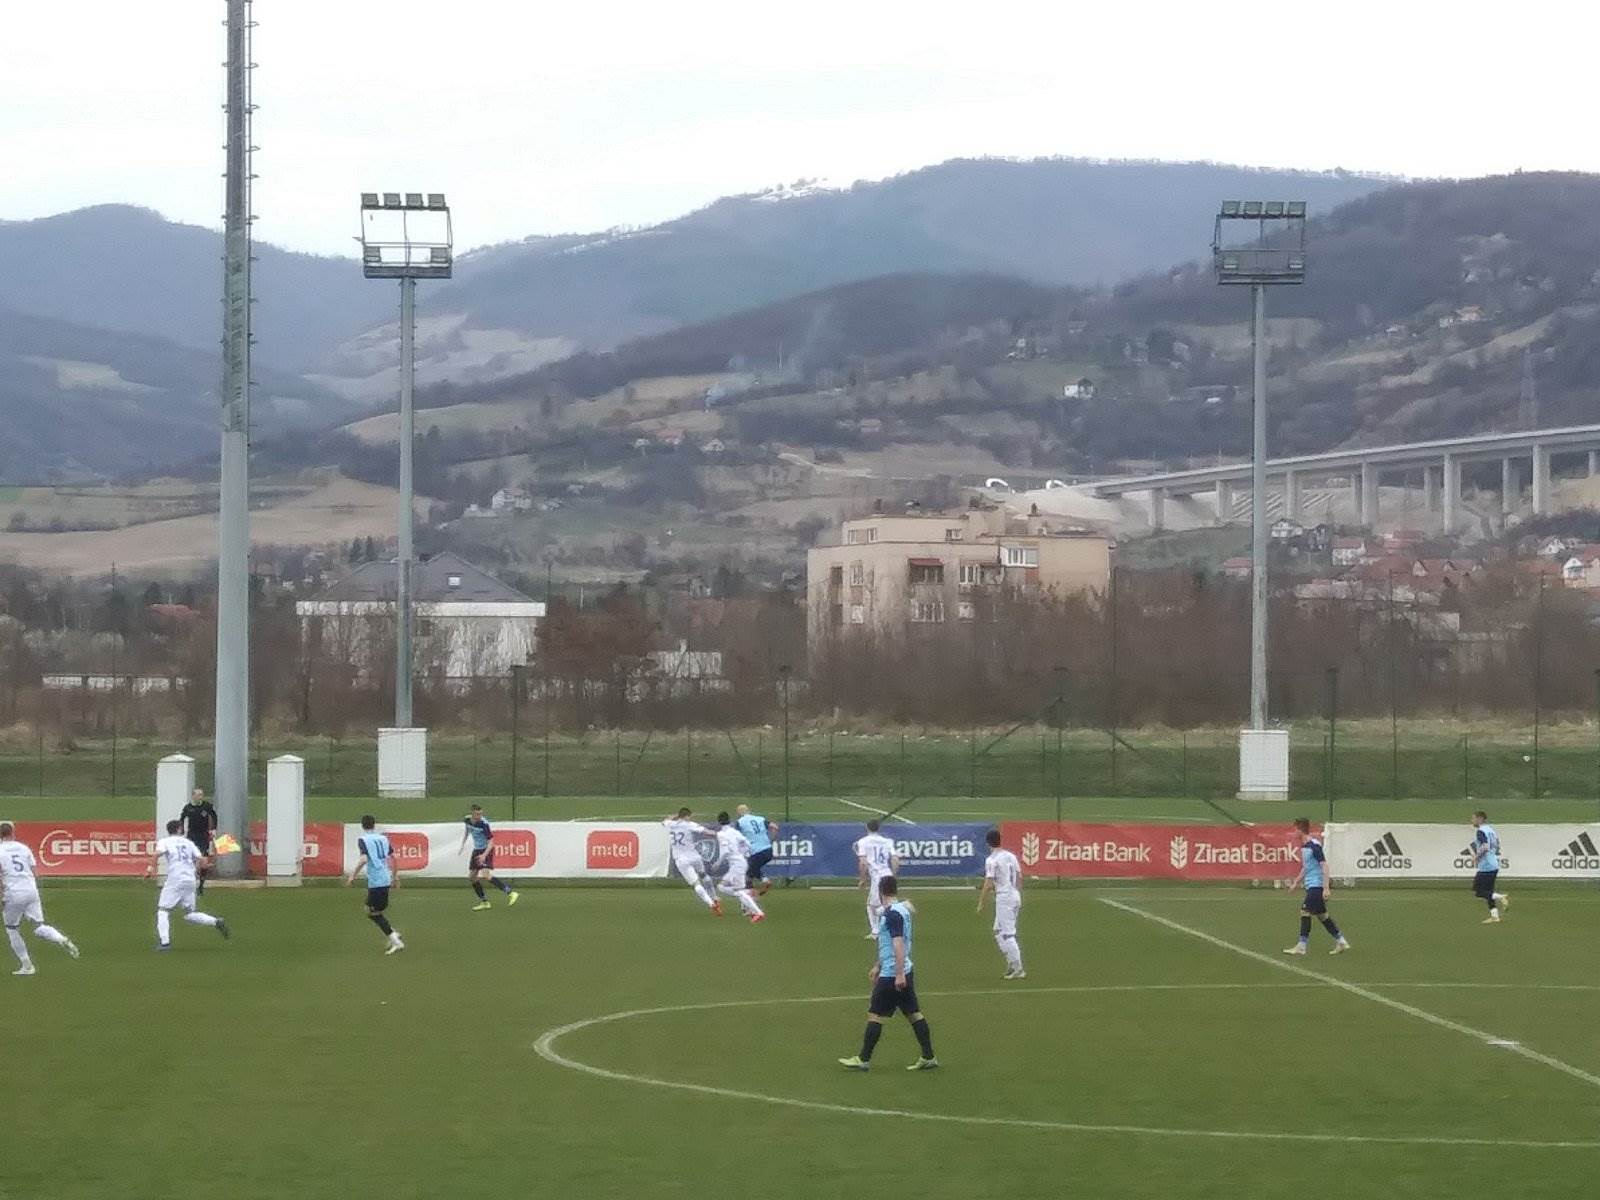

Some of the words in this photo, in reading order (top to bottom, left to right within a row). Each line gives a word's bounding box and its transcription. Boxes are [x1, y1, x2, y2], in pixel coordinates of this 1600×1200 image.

[592, 842, 632, 857] m:tel
[894, 835, 974, 857] avaria
[1046, 839, 1100, 862] Ziraat
[1104, 842, 1151, 863] Bank
[1194, 843, 1248, 864] Ziraat
[1252, 842, 1300, 864] Bank
[11, 854, 24, 872] 5
[1357, 854, 1412, 869] adidas
[1552, 854, 1600, 869] adida
